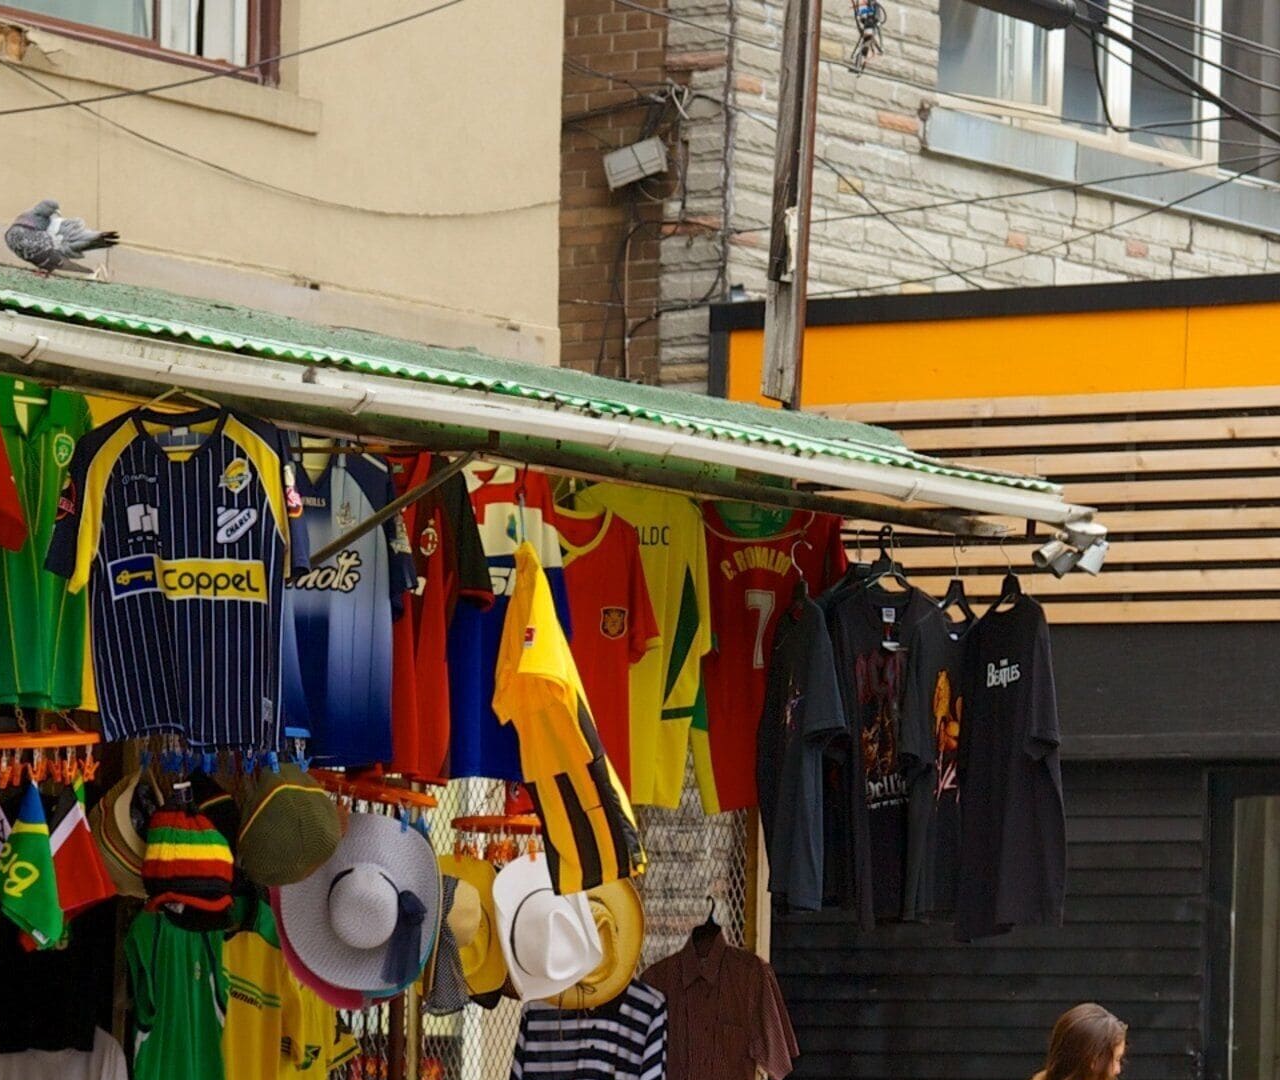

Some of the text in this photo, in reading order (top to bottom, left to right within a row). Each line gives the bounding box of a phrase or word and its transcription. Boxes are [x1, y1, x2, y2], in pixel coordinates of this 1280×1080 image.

[224, 509, 253, 538] CHARLY
[162, 567, 260, 597] Coppel
[744, 588, 776, 670] 7
[985, 661, 1021, 688] BEATLES
